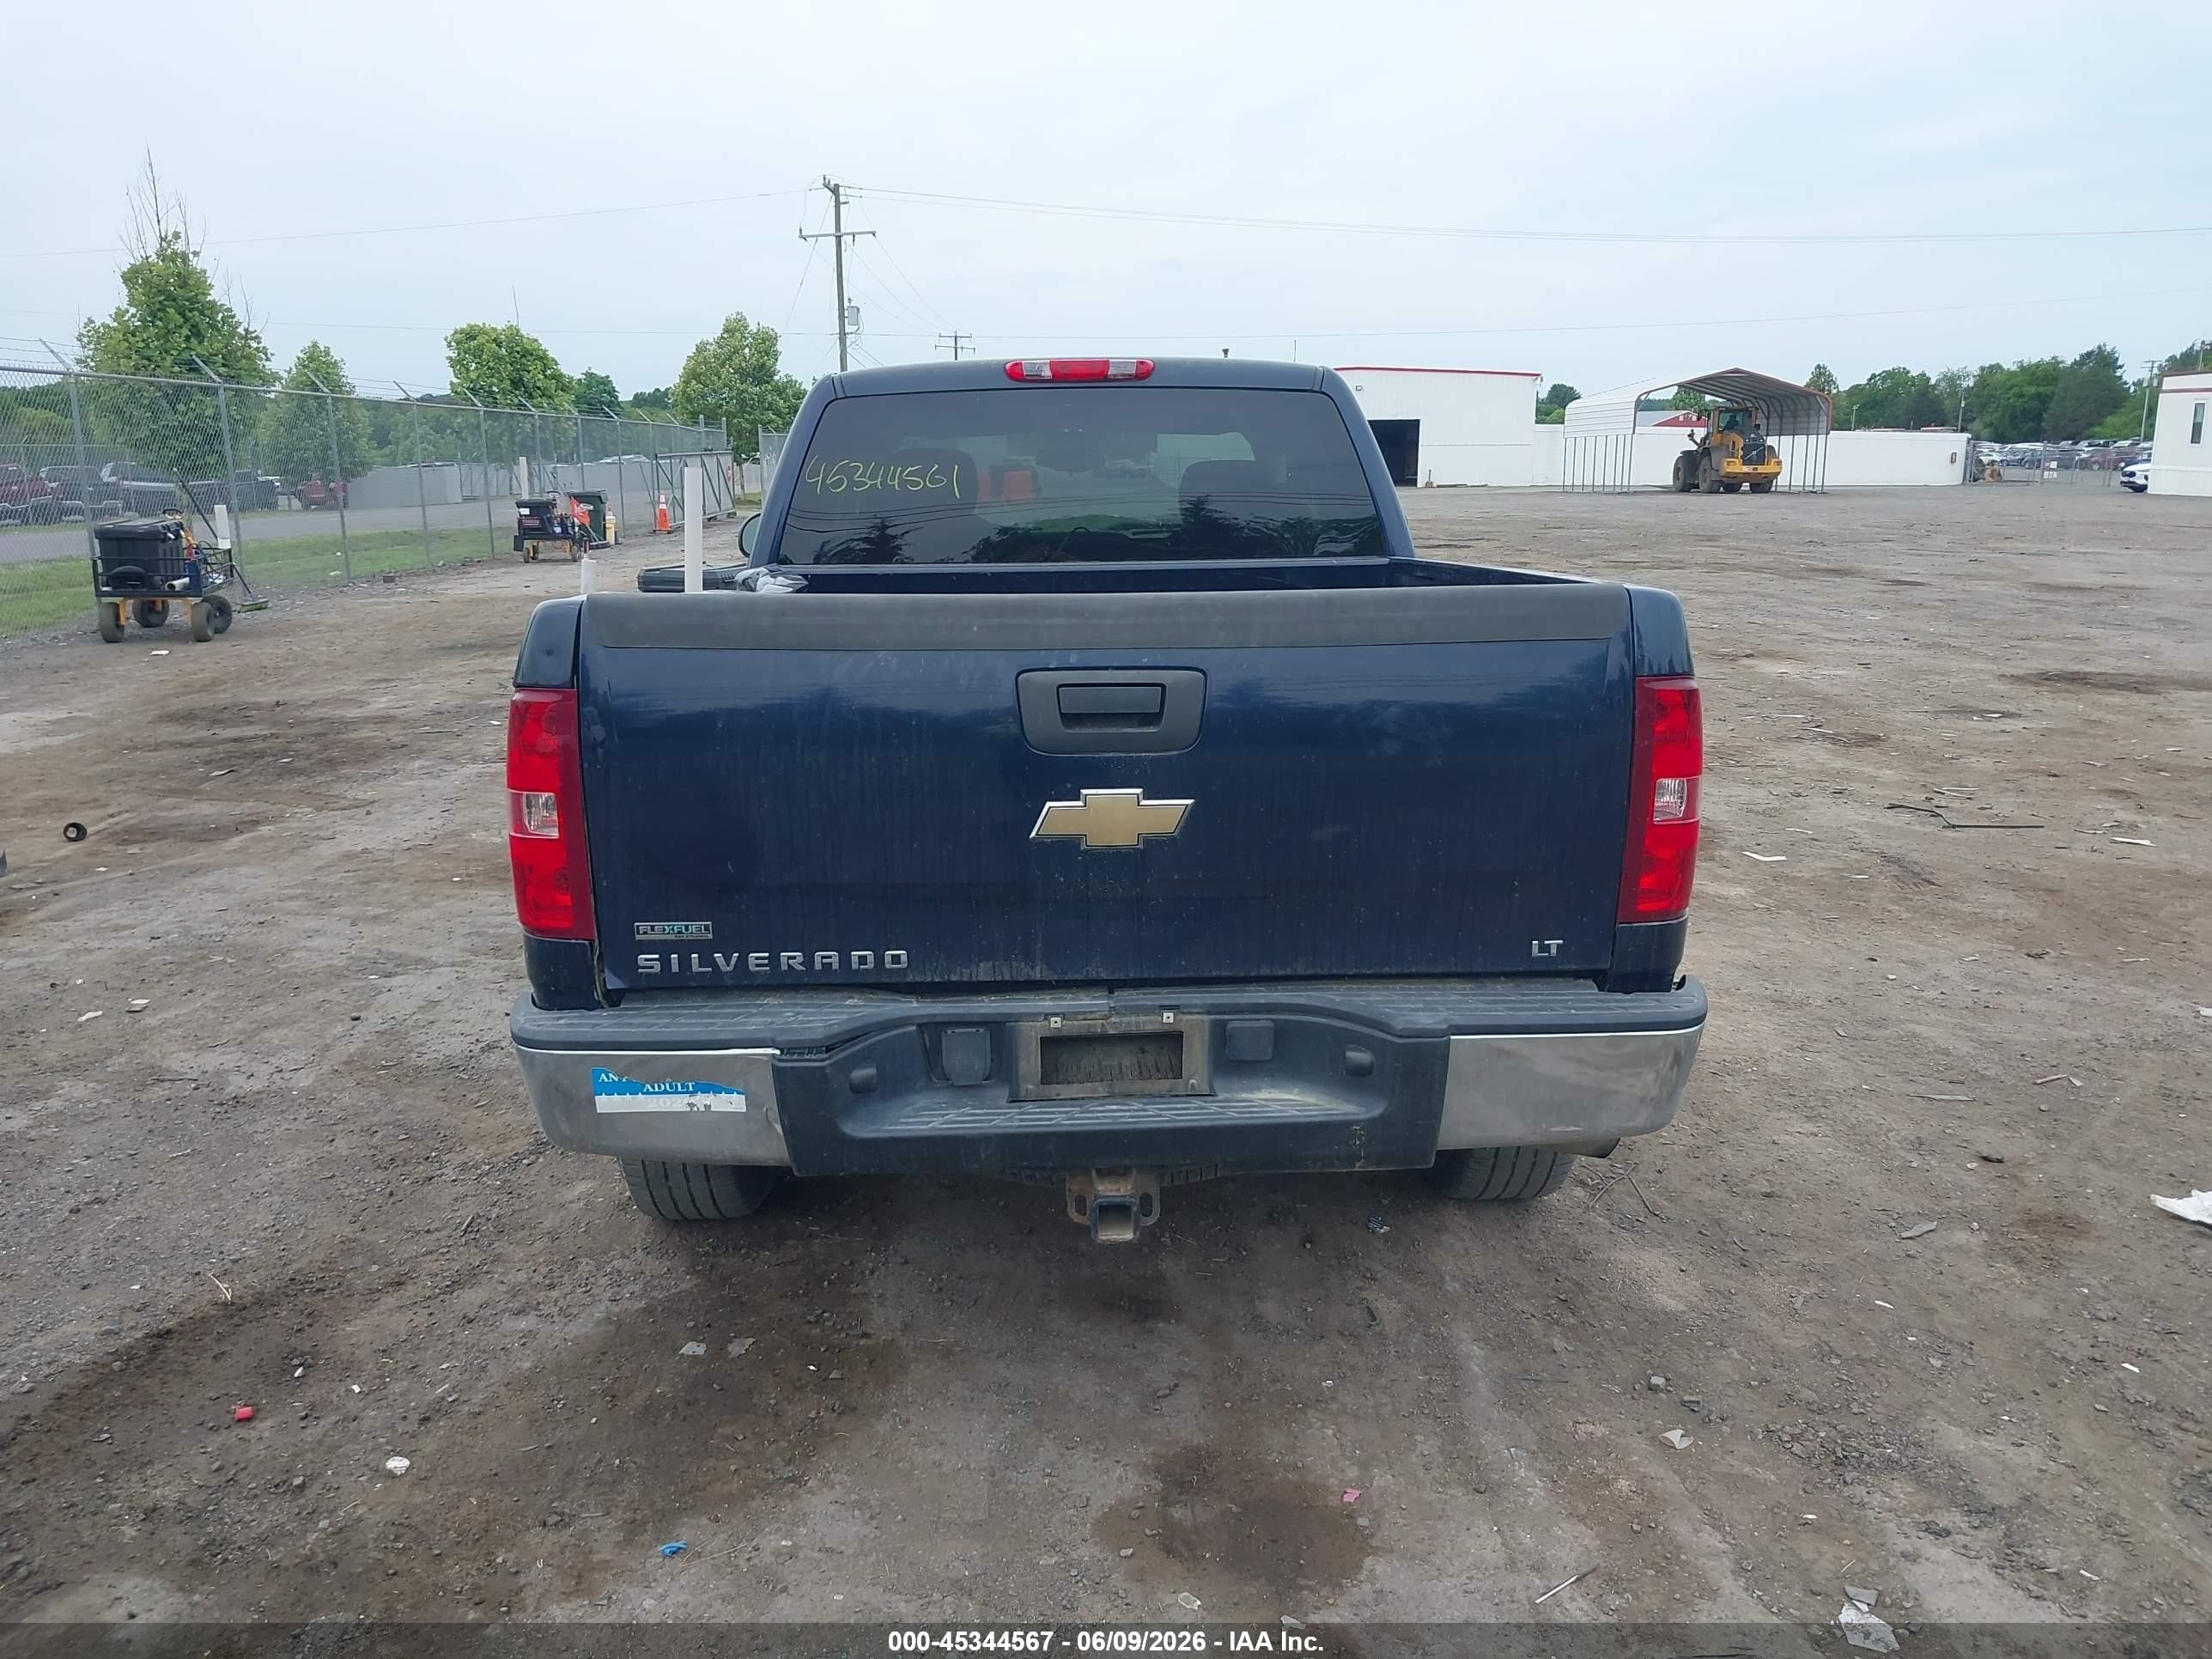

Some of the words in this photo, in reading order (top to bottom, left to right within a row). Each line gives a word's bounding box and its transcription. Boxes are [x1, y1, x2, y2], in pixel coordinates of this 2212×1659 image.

[639, 925, 709, 934] FLEXFUEL
[1531, 939, 1564, 957] LT
[637, 950, 908, 974] SILVERADO
[643, 1082, 696, 1093] ADULT
